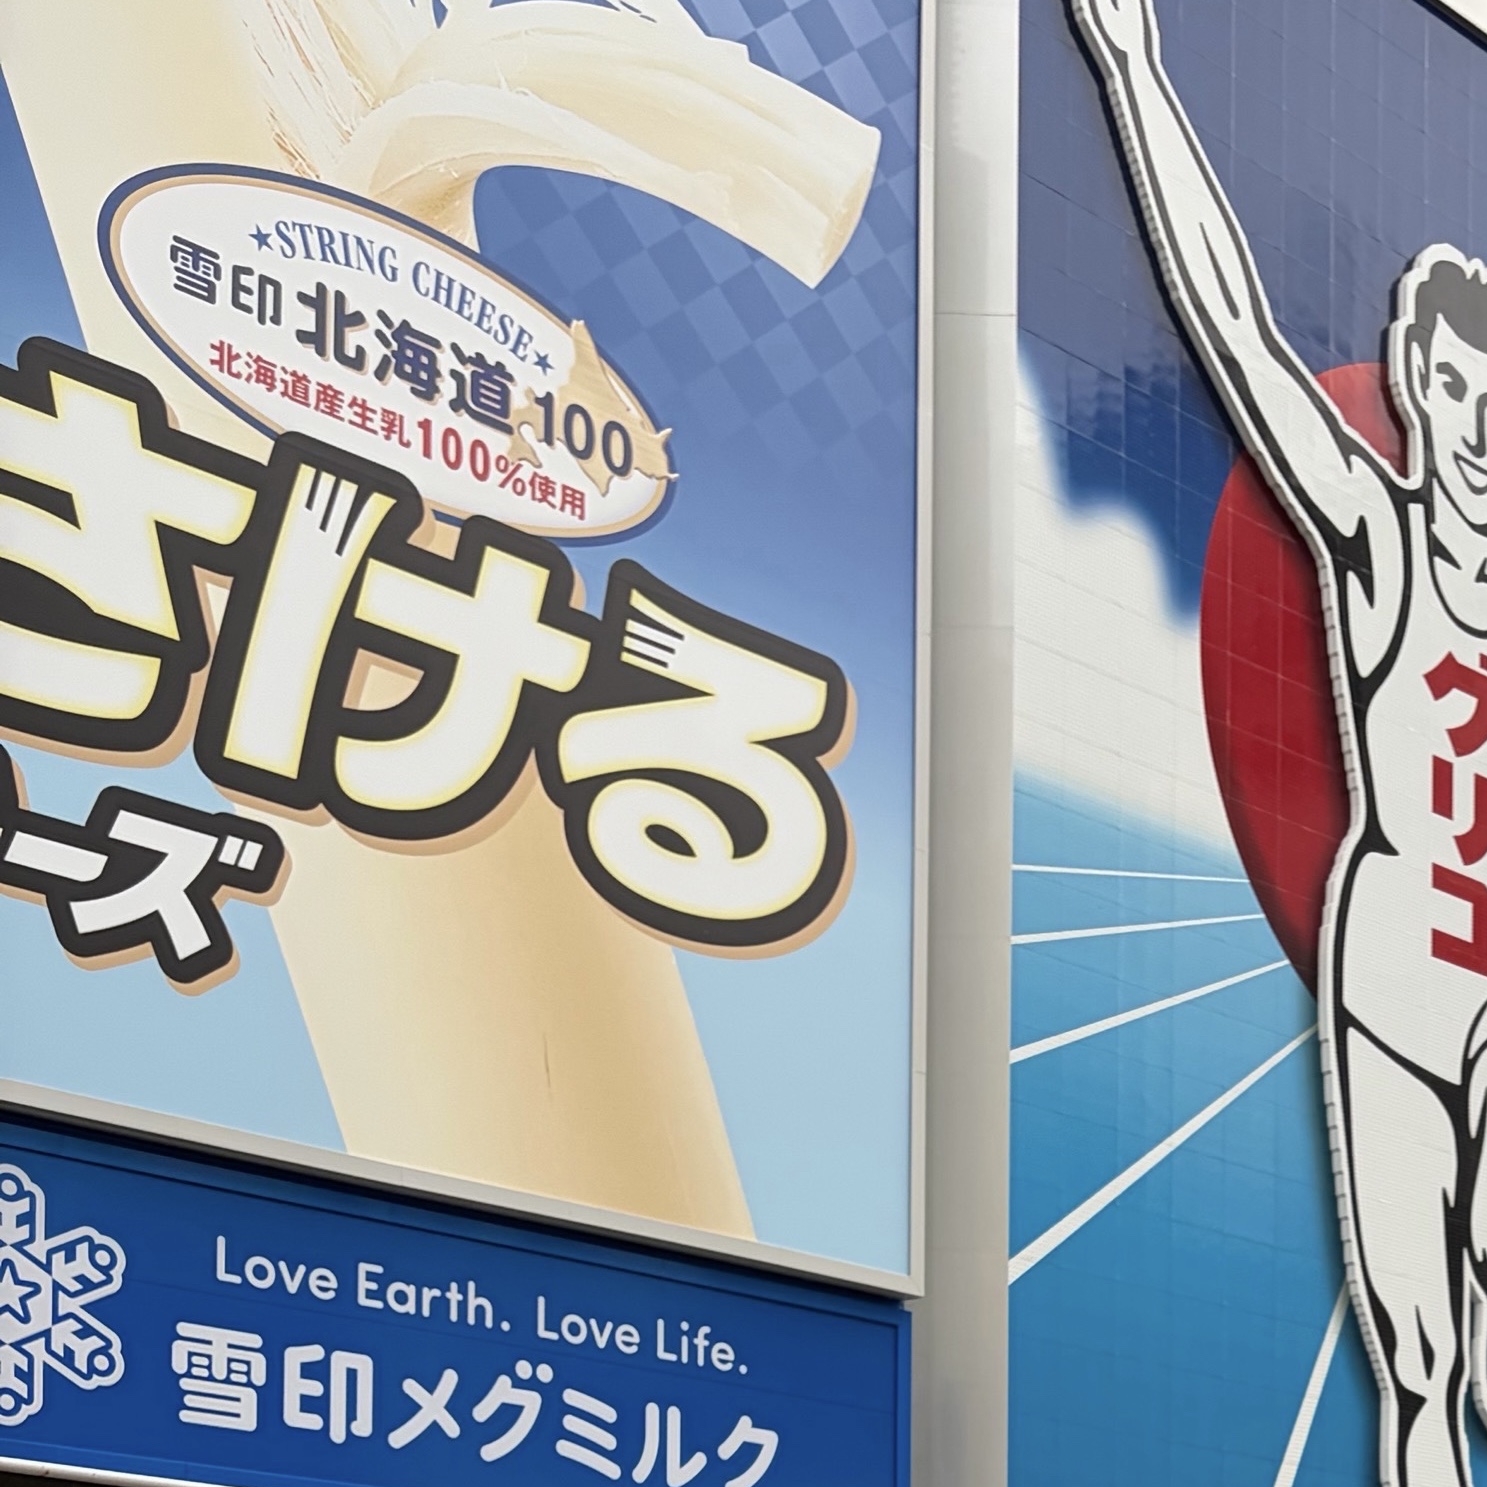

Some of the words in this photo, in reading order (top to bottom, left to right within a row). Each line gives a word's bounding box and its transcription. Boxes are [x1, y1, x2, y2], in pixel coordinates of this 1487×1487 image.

[274, 220, 399, 283] STRING
[412, 261, 533, 362] CHEESE
[209, 340, 586, 520] 北海道産生乳100%使用
[0, 811, 263, 959] ーズ
[215, 1235, 339, 1302] Love
[357, 1263, 511, 1333] Earth.
[536, 1296, 640, 1355] Love
[656, 1319, 749, 1375] Life.
